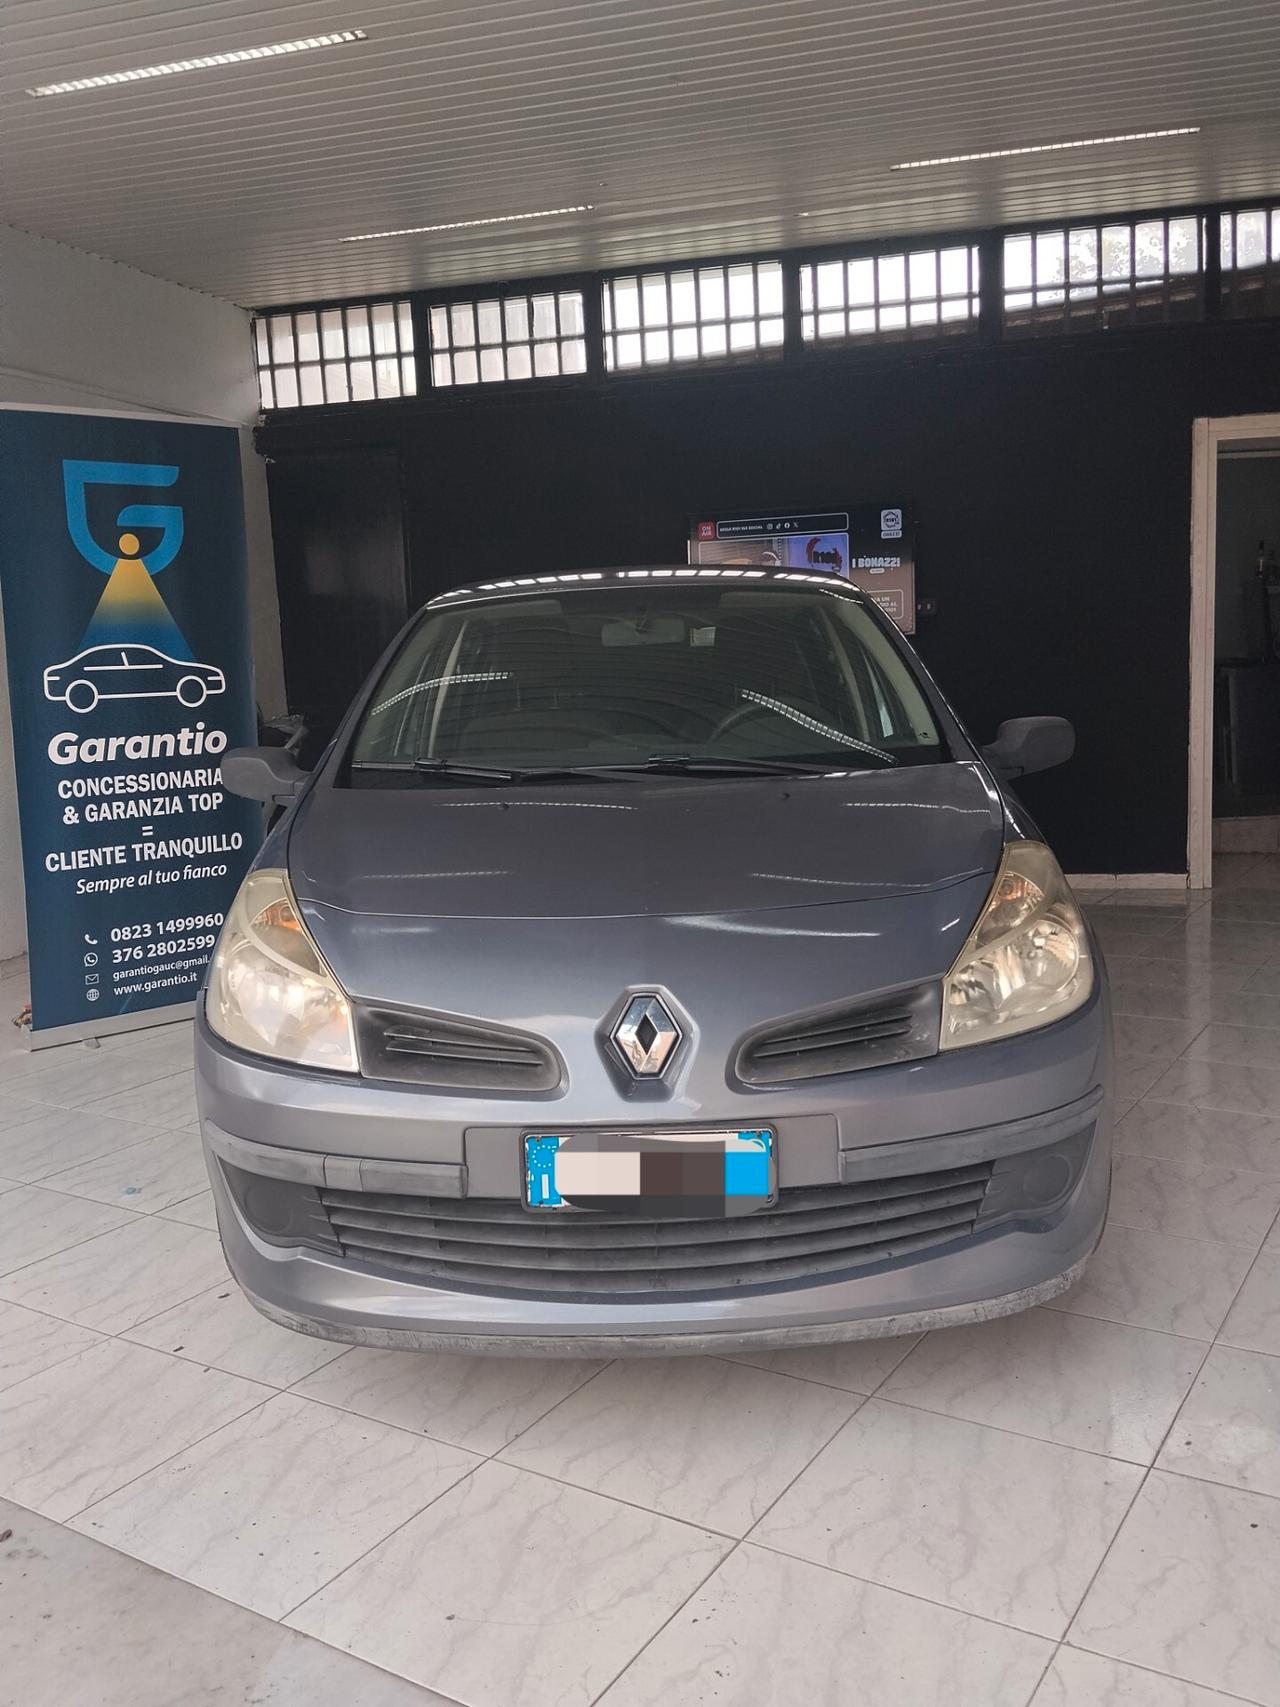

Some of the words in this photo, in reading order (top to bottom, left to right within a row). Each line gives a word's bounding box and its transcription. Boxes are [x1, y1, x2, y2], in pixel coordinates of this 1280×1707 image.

[48, 721, 227, 765] Garantio
[57, 768, 223, 799] CONCESSIONARIA
[62, 806, 79, 825] &
[85, 797, 184, 823] GARANZIA
[188, 792, 223, 812] TOP
[45, 845, 126, 872] CLIENTE
[132, 832, 243, 862] TRANQUILLO
[76, 873, 135, 895] Sempre
[138, 870, 152, 887] al
[155, 867, 180, 884] tuo
[183, 864, 227, 881] fianco
[110, 923, 152, 942] 0823
[156, 913, 224, 935] 1499960
[112, 945, 143, 964] 376
[147, 934, 215, 958] 2802599
[113, 954, 210, 981] garantiogauc@gmail.
[113, 972, 198, 996] www.garantio.it
